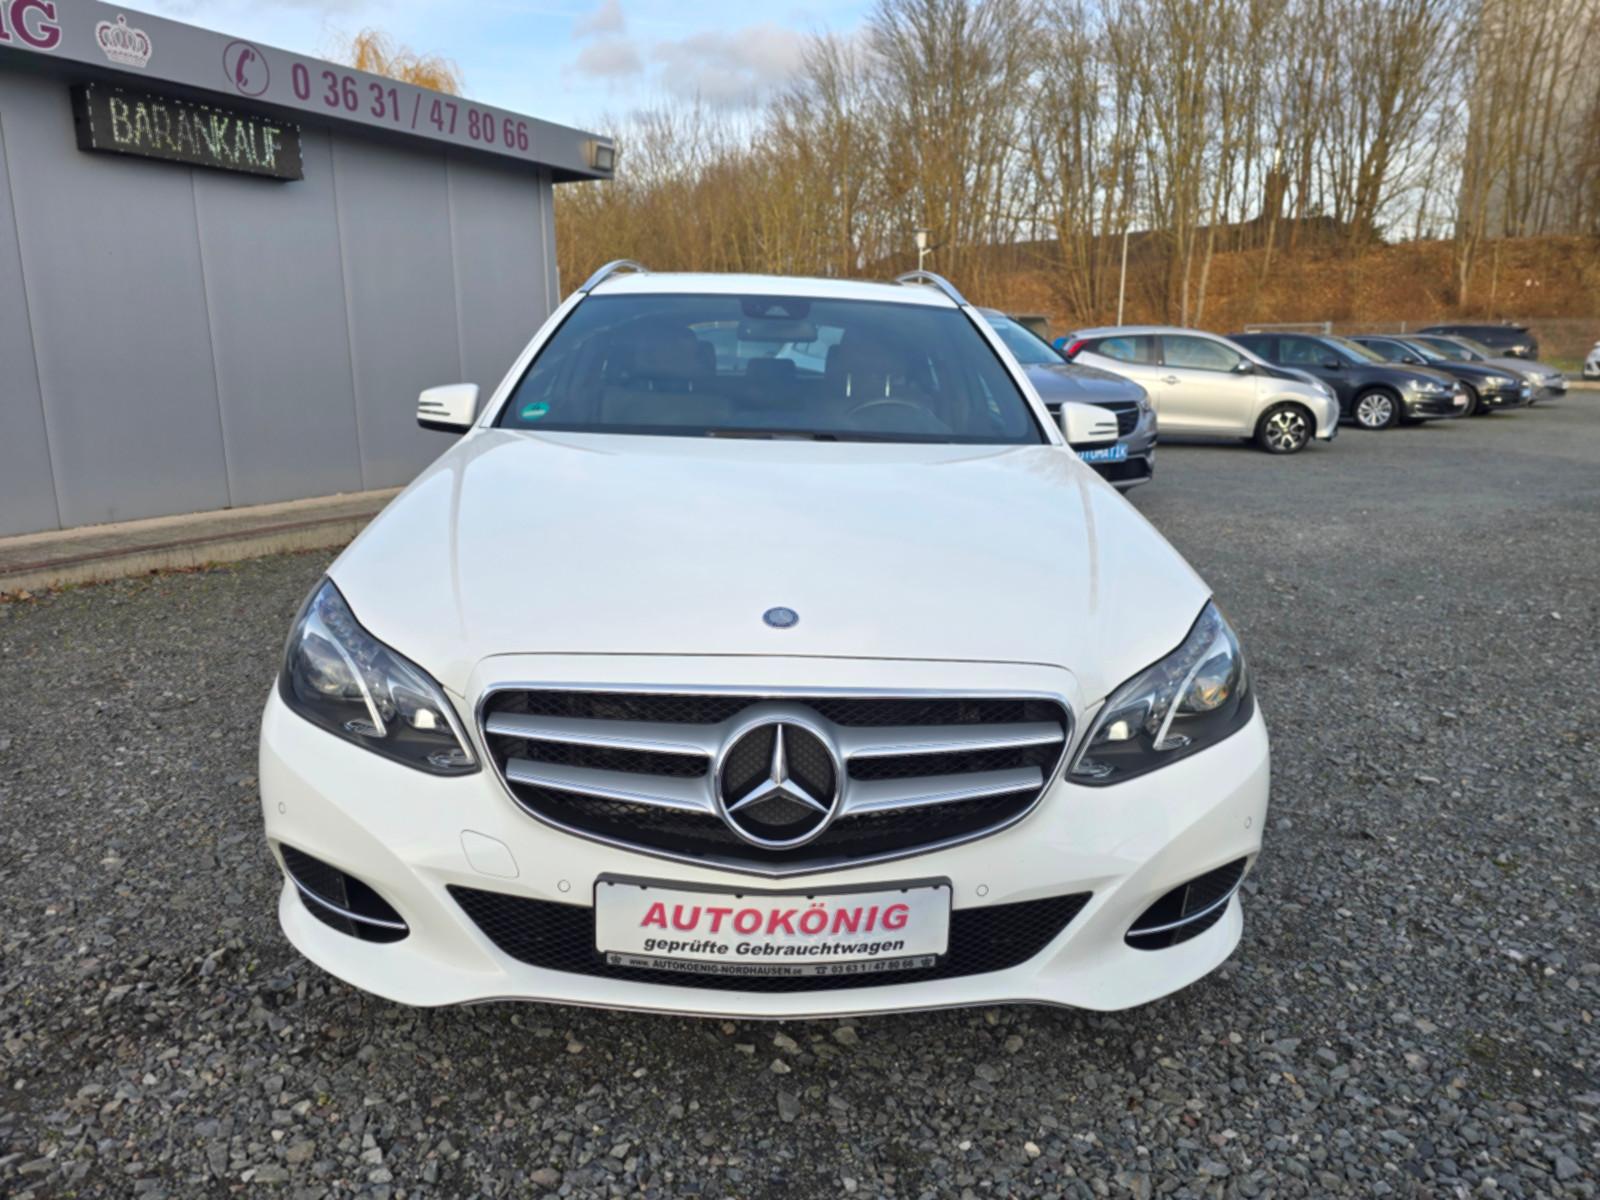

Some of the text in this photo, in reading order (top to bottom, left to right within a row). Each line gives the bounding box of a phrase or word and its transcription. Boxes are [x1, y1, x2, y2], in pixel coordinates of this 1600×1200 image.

[292, 63, 528, 151] 0 36 31 / 47 80 66
[1077, 444, 1128, 460] UTOMATIK
[640, 902, 910, 936] AUTOKÖNIG
[644, 938, 905, 956] geprüfte Gebrauchtwagen
